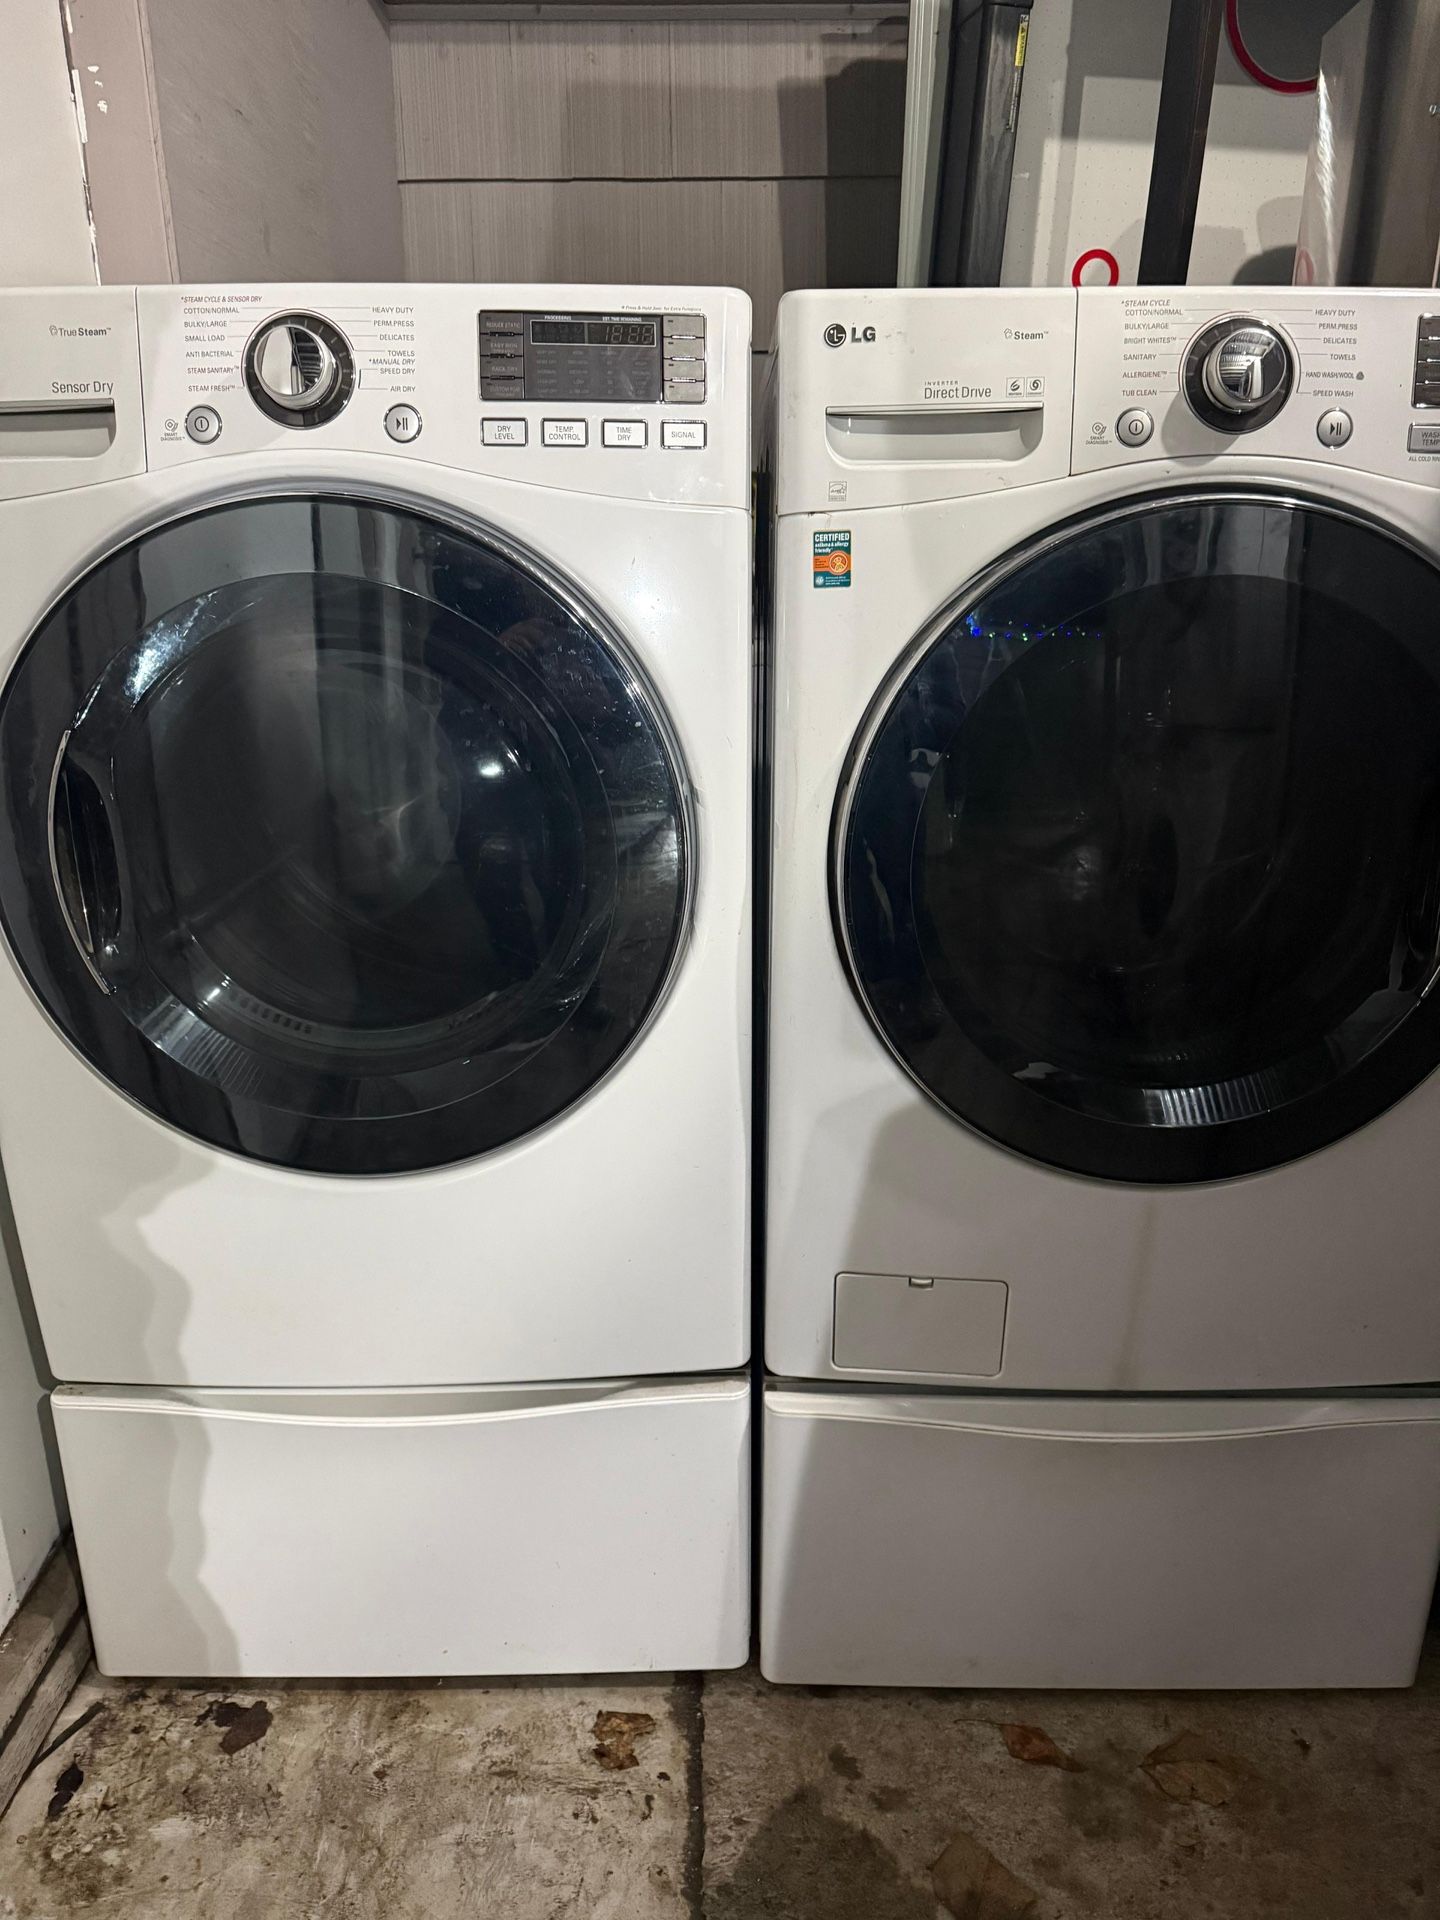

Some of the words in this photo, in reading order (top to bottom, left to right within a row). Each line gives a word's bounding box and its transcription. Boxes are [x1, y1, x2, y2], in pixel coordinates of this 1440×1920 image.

[851, 326, 876, 343] LG
[52, 382, 90, 393] Sensor
[94, 381, 113, 395] Dry
[924, 387, 959, 399] Direct
[961, 386, 991, 398] Drive
[815, 533, 849, 542] CERTIFIED
